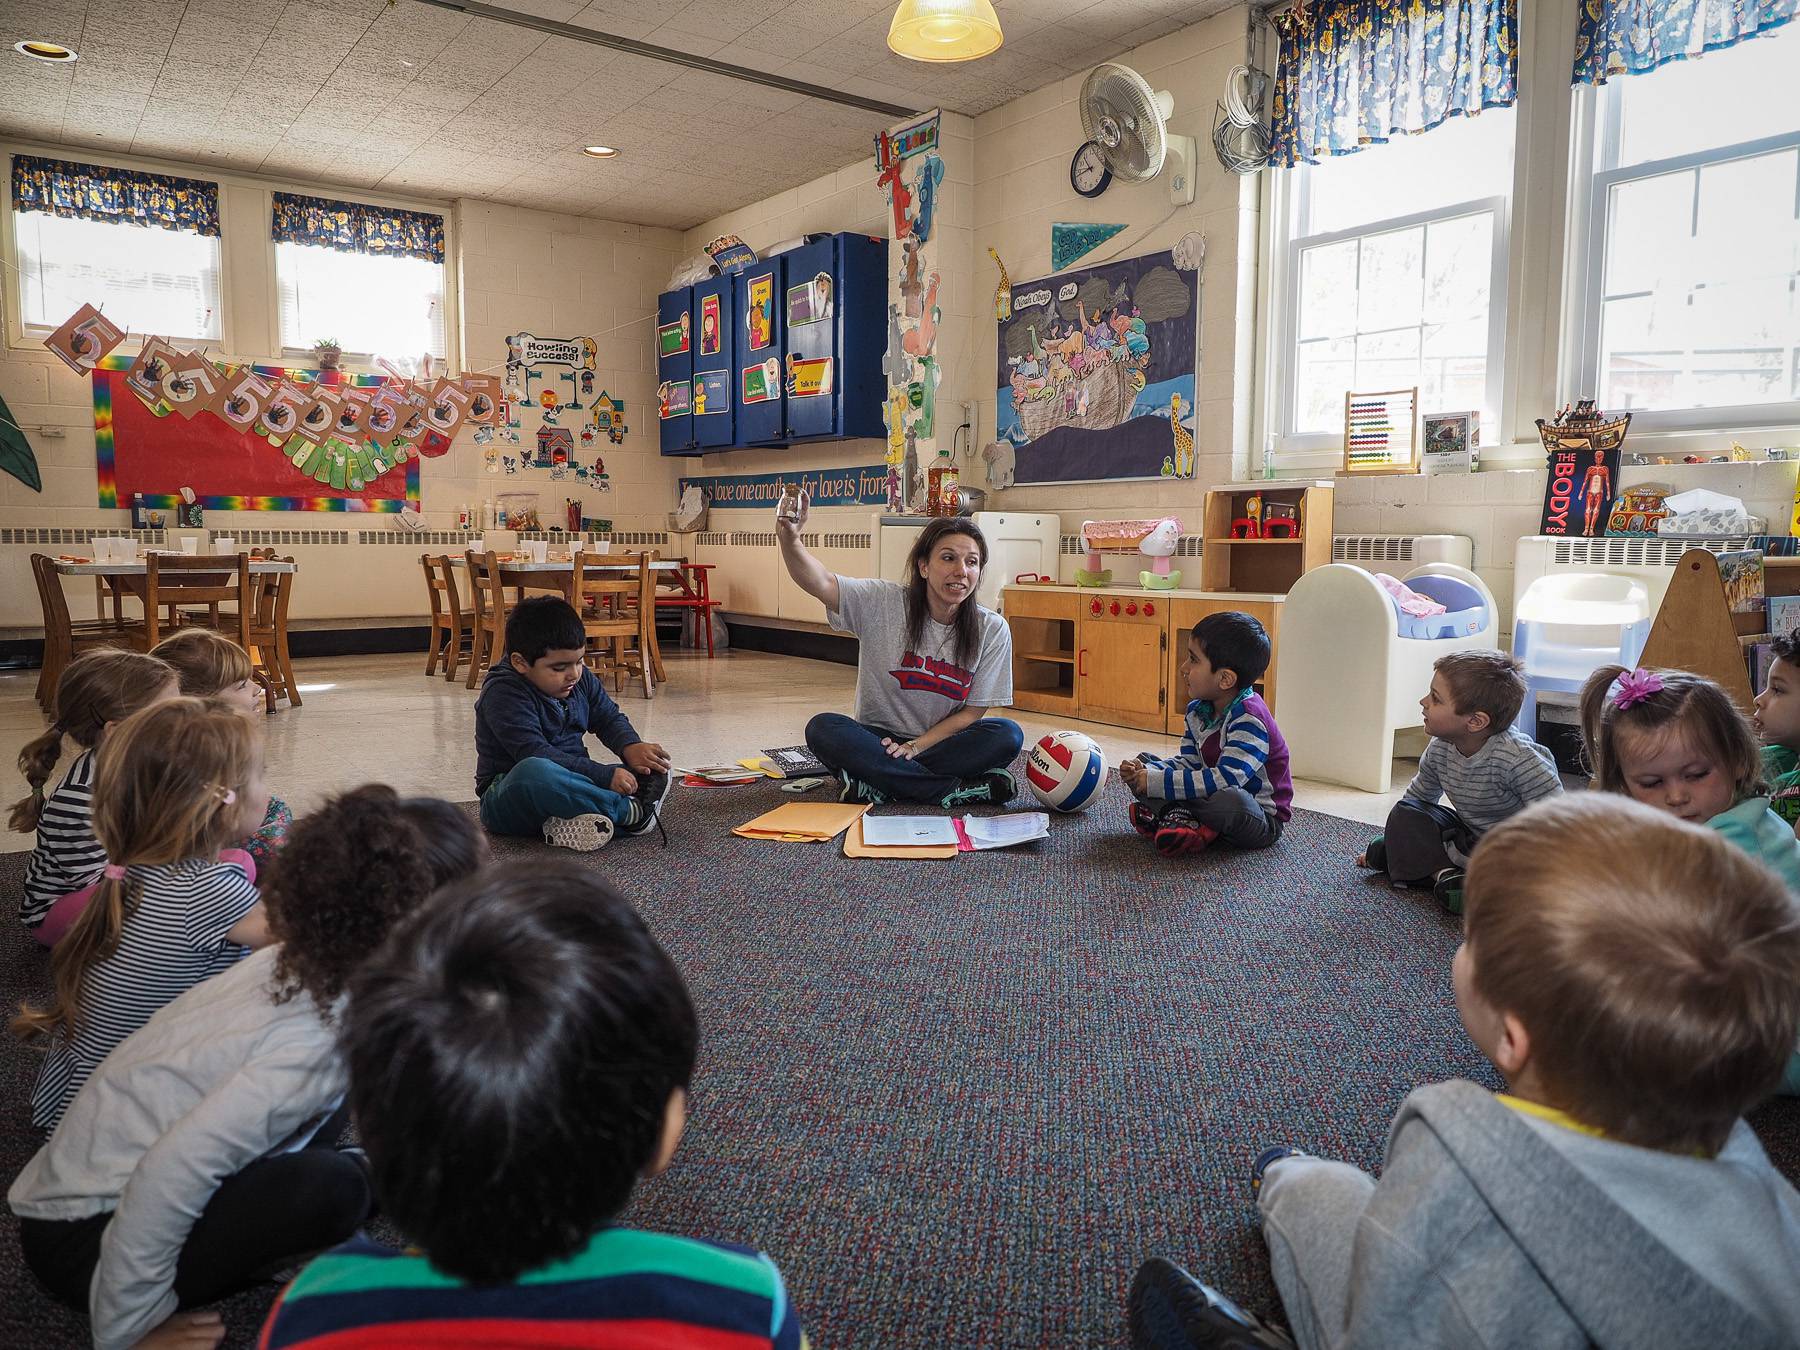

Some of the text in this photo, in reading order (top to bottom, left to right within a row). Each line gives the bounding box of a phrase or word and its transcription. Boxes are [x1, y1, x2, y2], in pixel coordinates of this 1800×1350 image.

[1015, 294, 1032, 308] Noah
[1033, 291, 1050, 304] Obeys
[526, 351, 579, 361] Success!
[528, 342, 579, 354] Howling
[223, 376, 273, 424] 5
[427, 384, 469, 429] 5
[1557, 453, 1577, 462] THE
[715, 480, 734, 501] love
[736, 484, 754, 501] one
[802, 474, 817, 498] for
[819, 473, 843, 498] love
[844, 474, 855, 497] is
[1548, 462, 1576, 527] BODY
